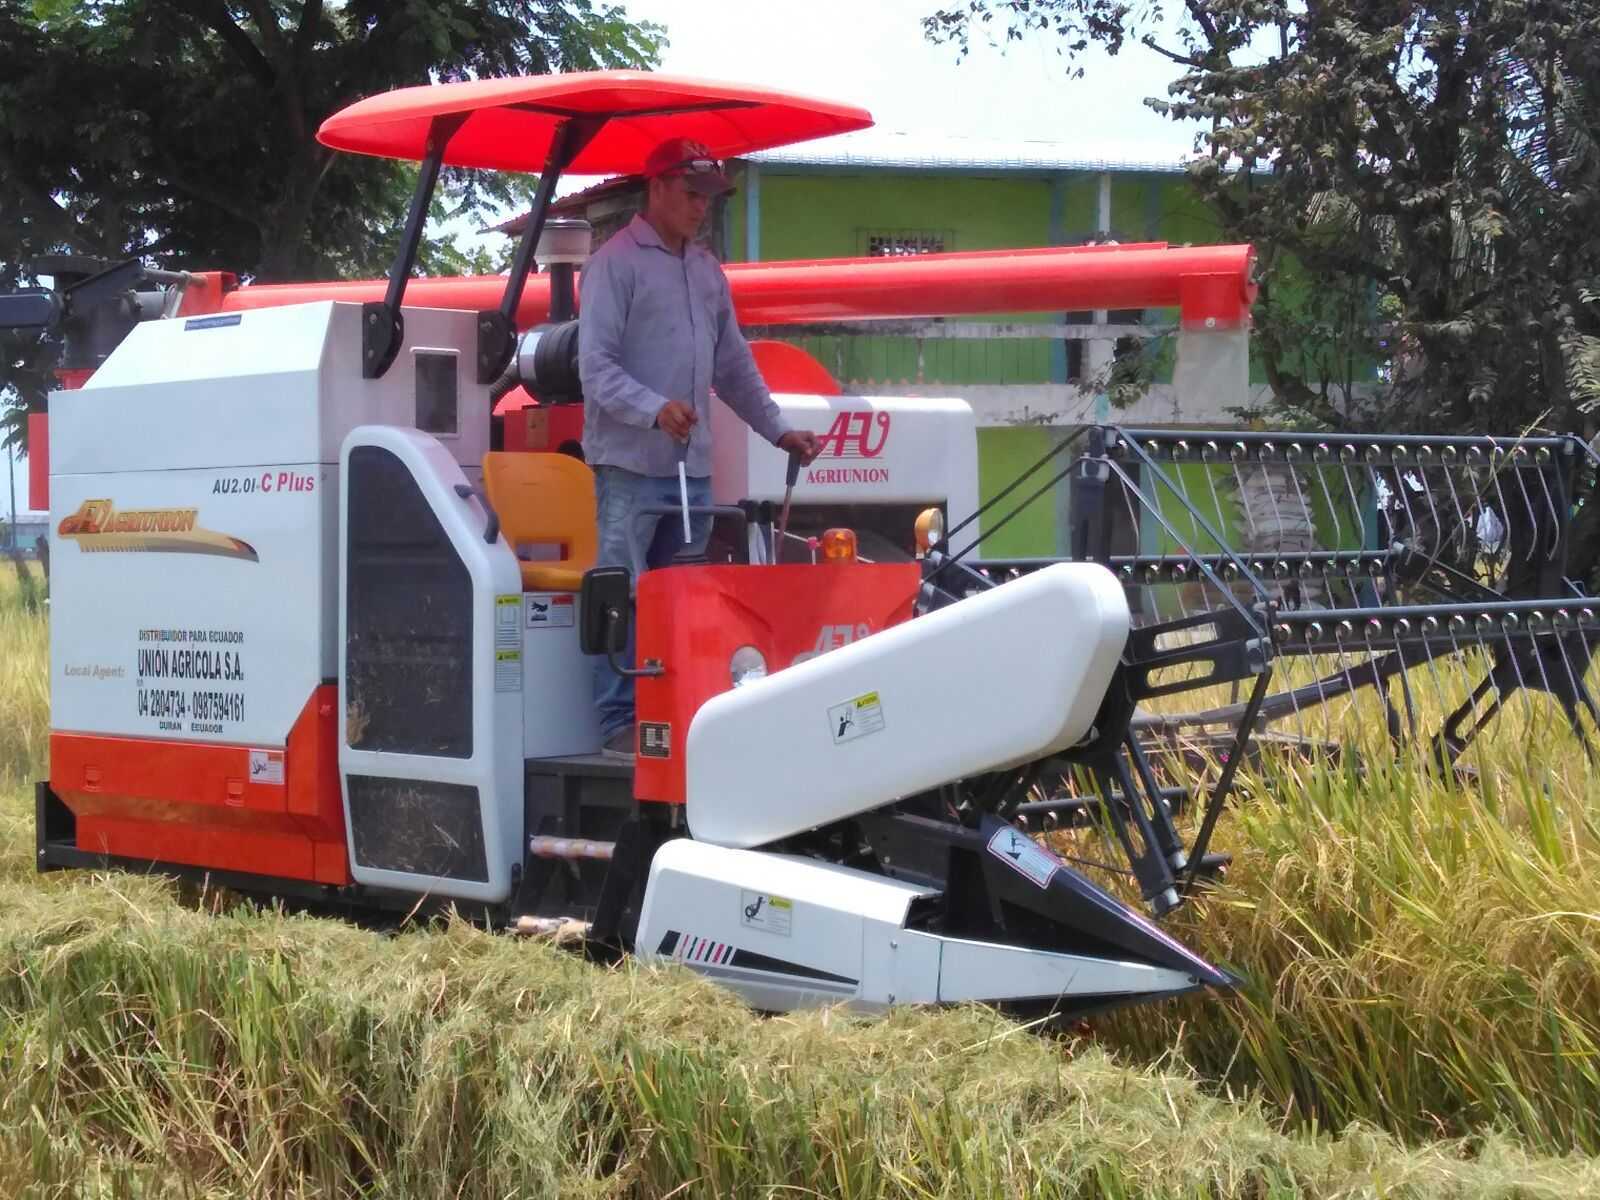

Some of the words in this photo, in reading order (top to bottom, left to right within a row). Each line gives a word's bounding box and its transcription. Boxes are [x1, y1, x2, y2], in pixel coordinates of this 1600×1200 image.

[277, 472, 315, 492] Plus
[806, 468, 889, 484] AGRIUNION
[138, 629, 187, 643] DISTRIBUIDOR
[189, 630, 208, 643] PARA
[209, 631, 244, 645] ECUADOR
[137, 643, 169, 678] UNIÓN
[171, 643, 222, 680] AGRÍCOLA
[224, 651, 245, 681] S.A.
[64, 663, 91, 677] Local
[92, 664, 126, 681] Agent:
[138, 689, 149, 717] 04
[150, 689, 186, 718] 2804734
[192, 691, 245, 722] 0987594161
[159, 721, 182, 731] DURAN
[191, 723, 224, 734] ECUADOR
